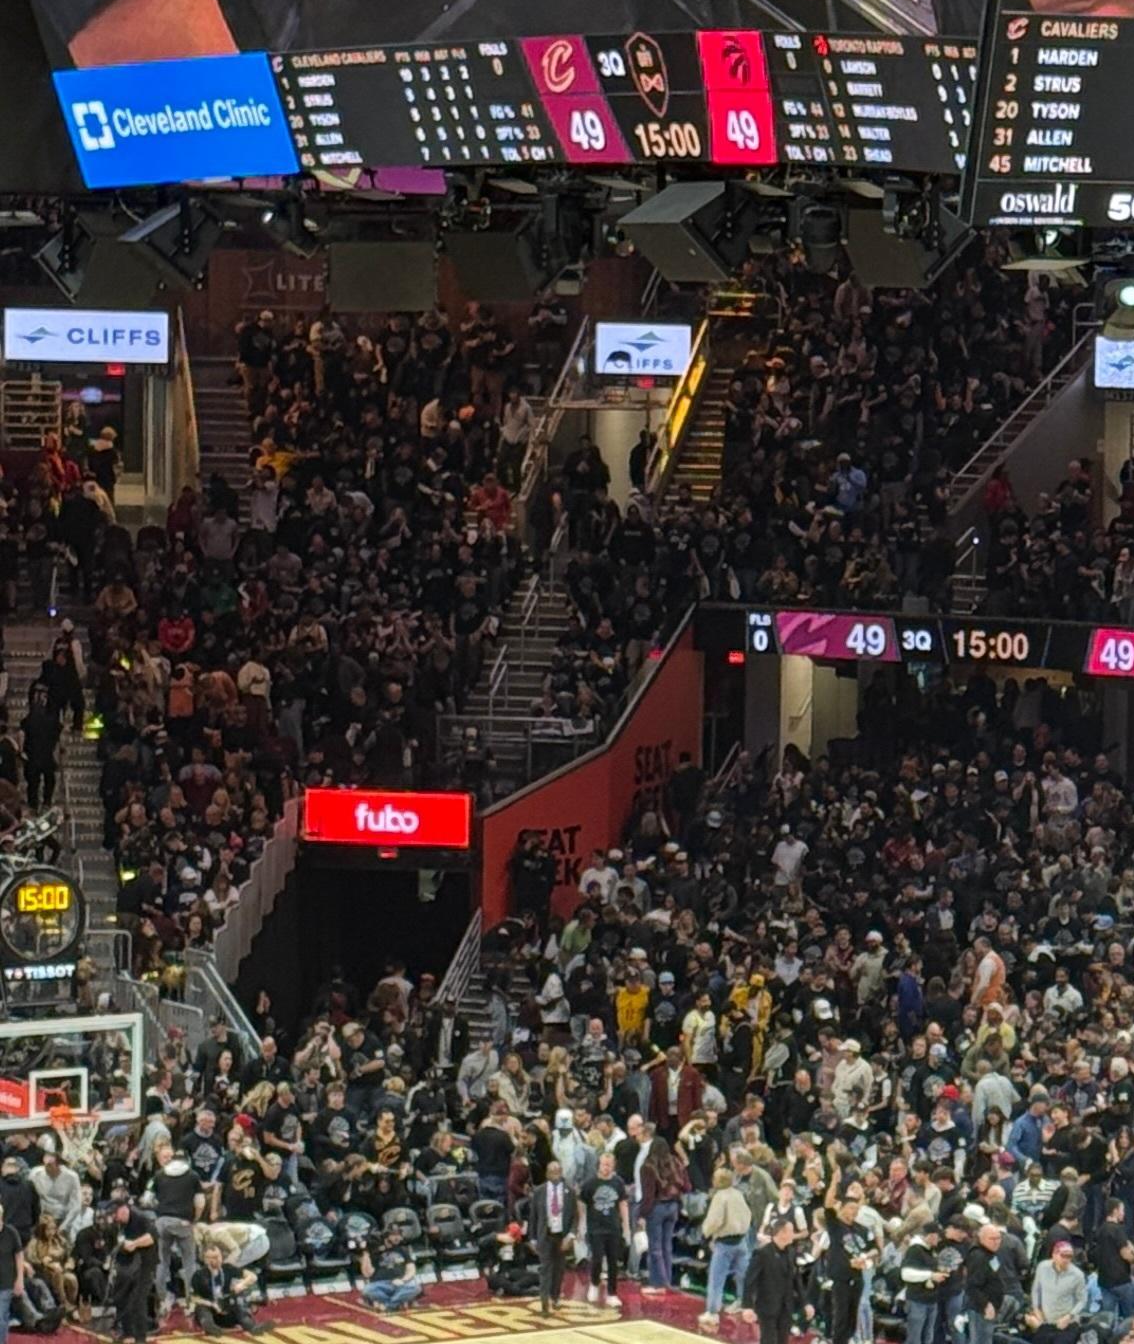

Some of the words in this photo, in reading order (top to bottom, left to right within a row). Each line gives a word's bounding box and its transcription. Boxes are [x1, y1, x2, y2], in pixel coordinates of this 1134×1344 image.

[1041, 21, 1117, 39] CAVALIERS
[598, 51, 625, 77] 3Q
[1012, 48, 1019, 64] 1
[1038, 49, 1097, 65] HARDEN
[1005, 74, 1016, 91] 2
[1034, 76, 1081, 92] STRUS
[112, 103, 211, 137] Cleveland
[216, 97, 271, 128] Clinic
[996, 101, 1018, 118] 20
[1032, 103, 1080, 119] TYSON
[570, 110, 605, 151] 49
[635, 122, 701, 157] 15:00
[727, 110, 759, 150] 49
[995, 128, 1012, 145] 31
[1027, 130, 1072, 145] ALLEN
[990, 155, 1010, 172] 45
[1024, 157, 1091, 172] MITCHELL
[1001, 184, 1077, 214] oswald
[276, 274, 324, 292] LITE
[66, 326, 161, 346] CLIFFS
[750, 614, 771, 625] FLS
[754, 630, 768, 651] 0
[846, 624, 885, 656] 49
[903, 631, 931, 650] 3Q
[953, 631, 1029, 660] 15:00
[1100, 638, 1134, 671] 49
[354, 802, 419, 833] fubo
[18, 886, 69, 911] 15:00
[24, 965, 75, 979] TISSOT
